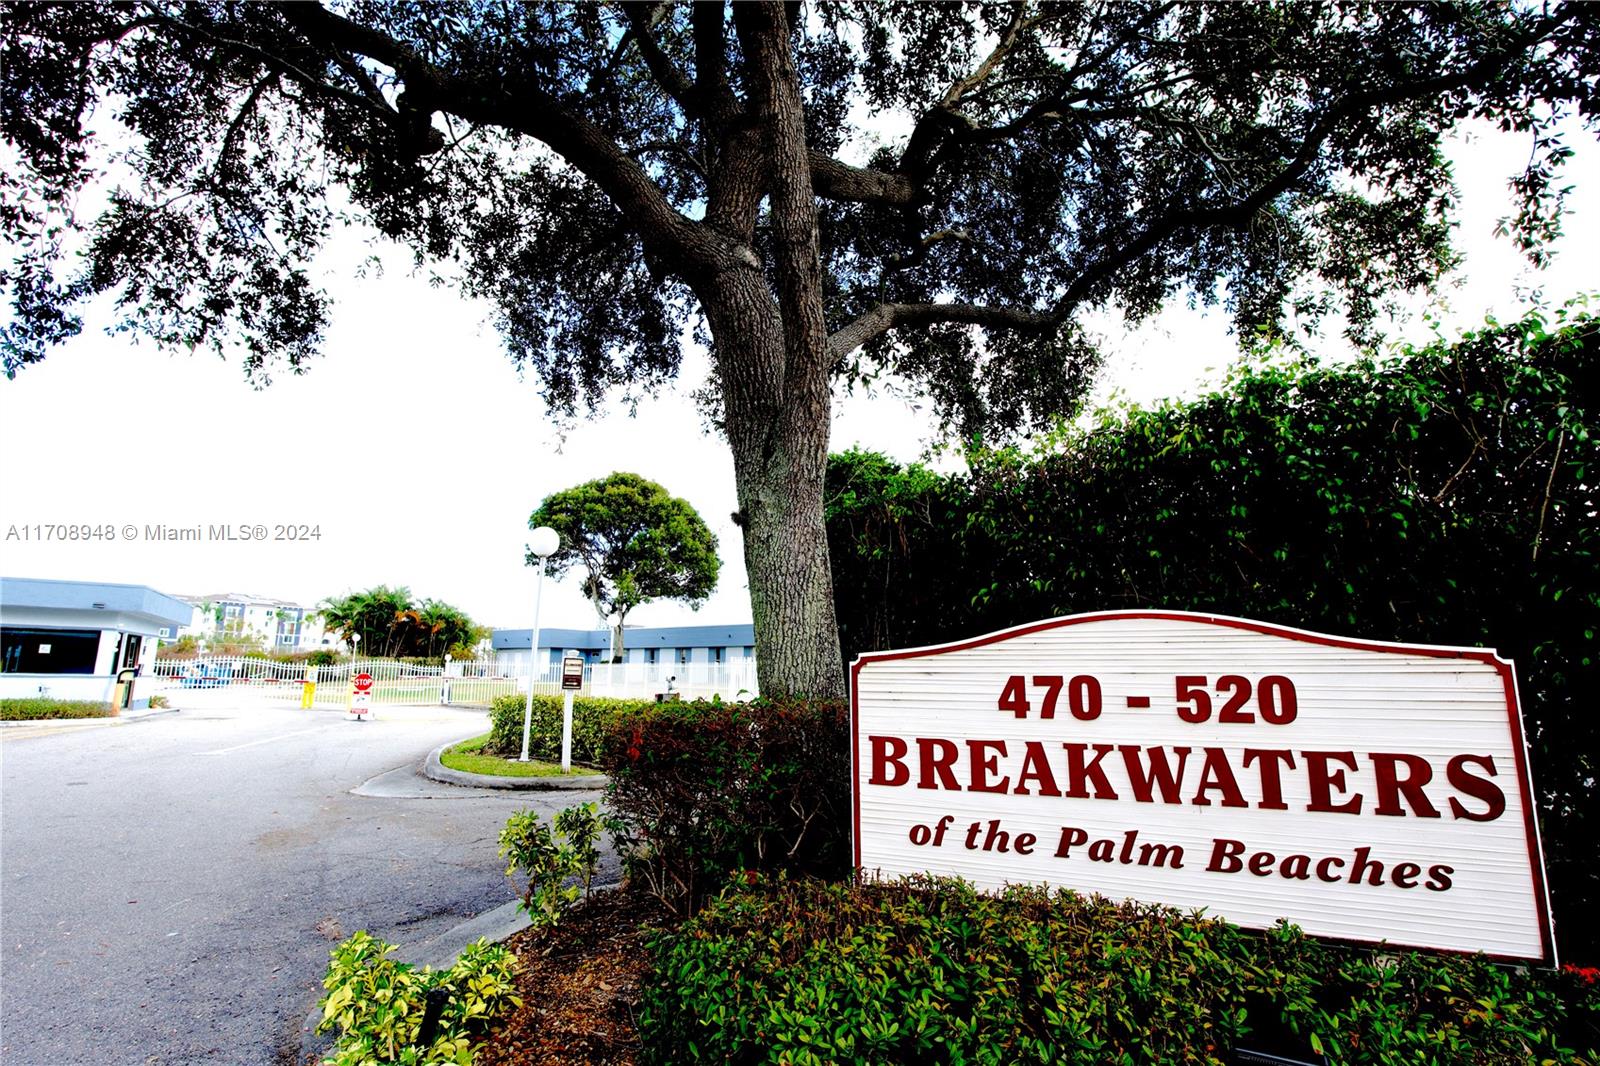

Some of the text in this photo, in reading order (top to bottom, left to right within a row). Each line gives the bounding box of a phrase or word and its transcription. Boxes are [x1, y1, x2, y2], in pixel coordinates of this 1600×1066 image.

[354, 678, 373, 687] STOP
[998, 674, 1299, 726] 470 - 520
[868, 735, 1507, 823] BREAKWATERS
[908, 815, 1456, 892] of the Palm Beaches
